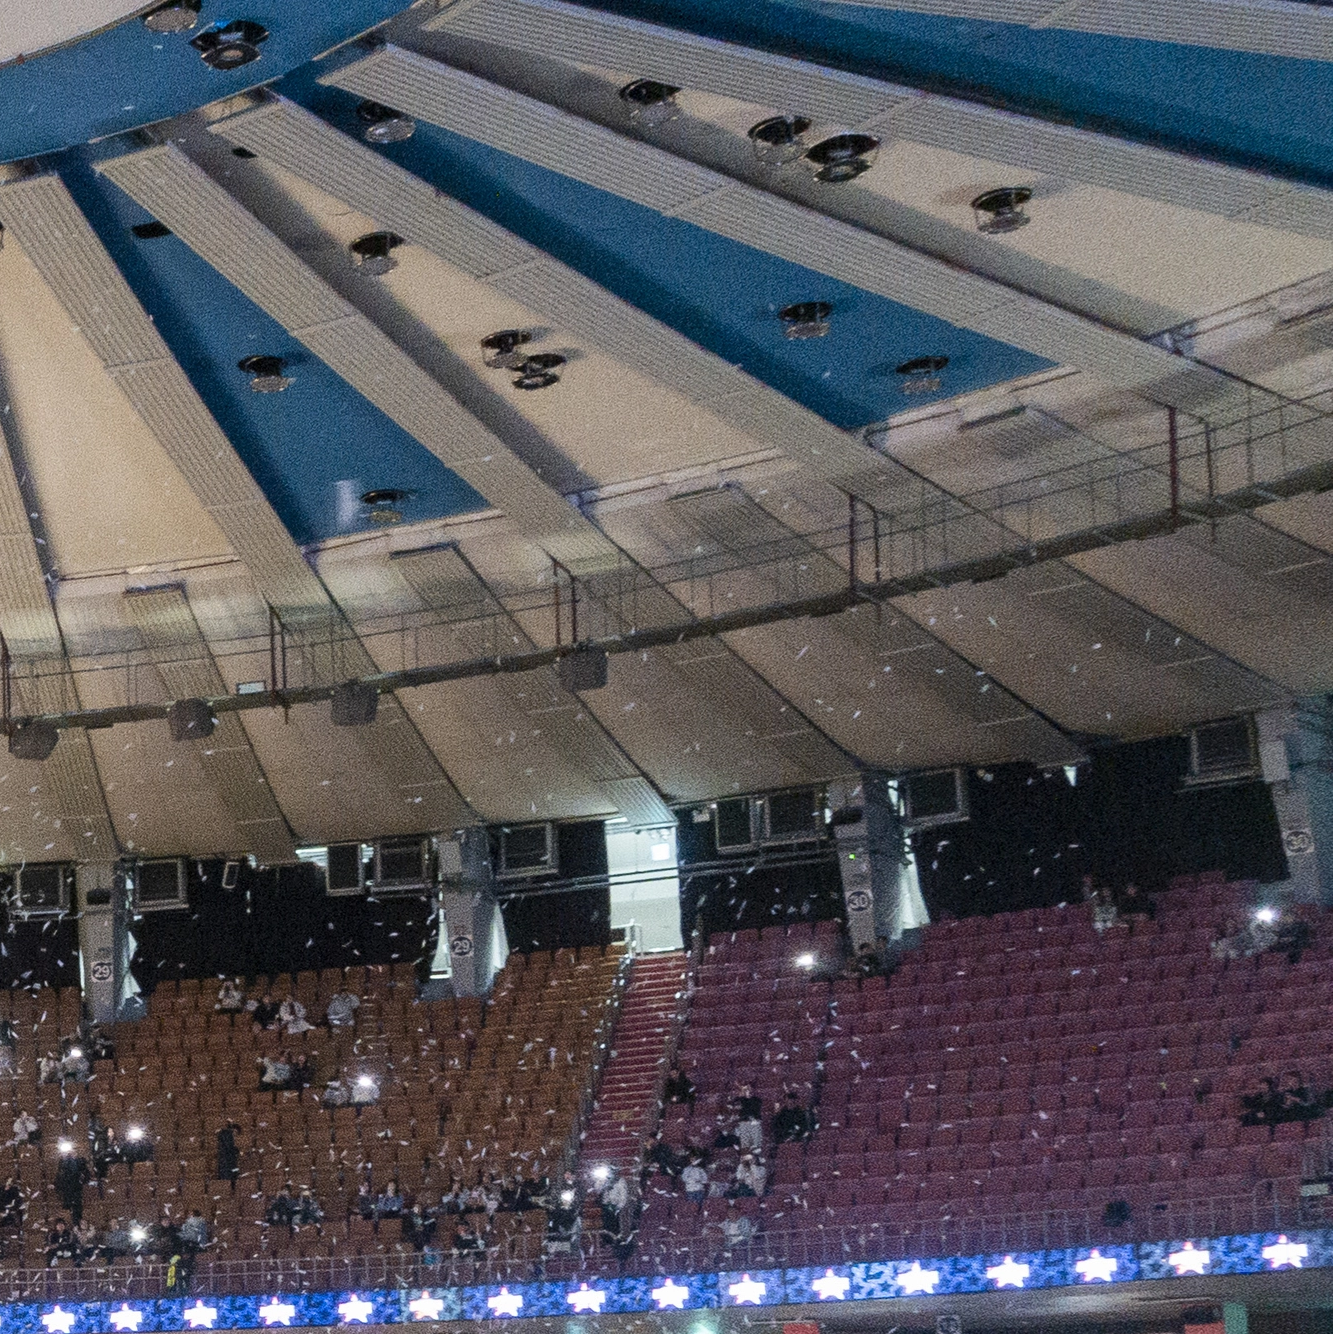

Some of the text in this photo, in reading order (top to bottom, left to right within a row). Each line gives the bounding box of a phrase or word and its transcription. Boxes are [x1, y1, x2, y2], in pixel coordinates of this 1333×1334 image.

[850, 894, 868, 908] 30
[453, 939, 470, 952] 29
[93, 965, 110, 978] 29
